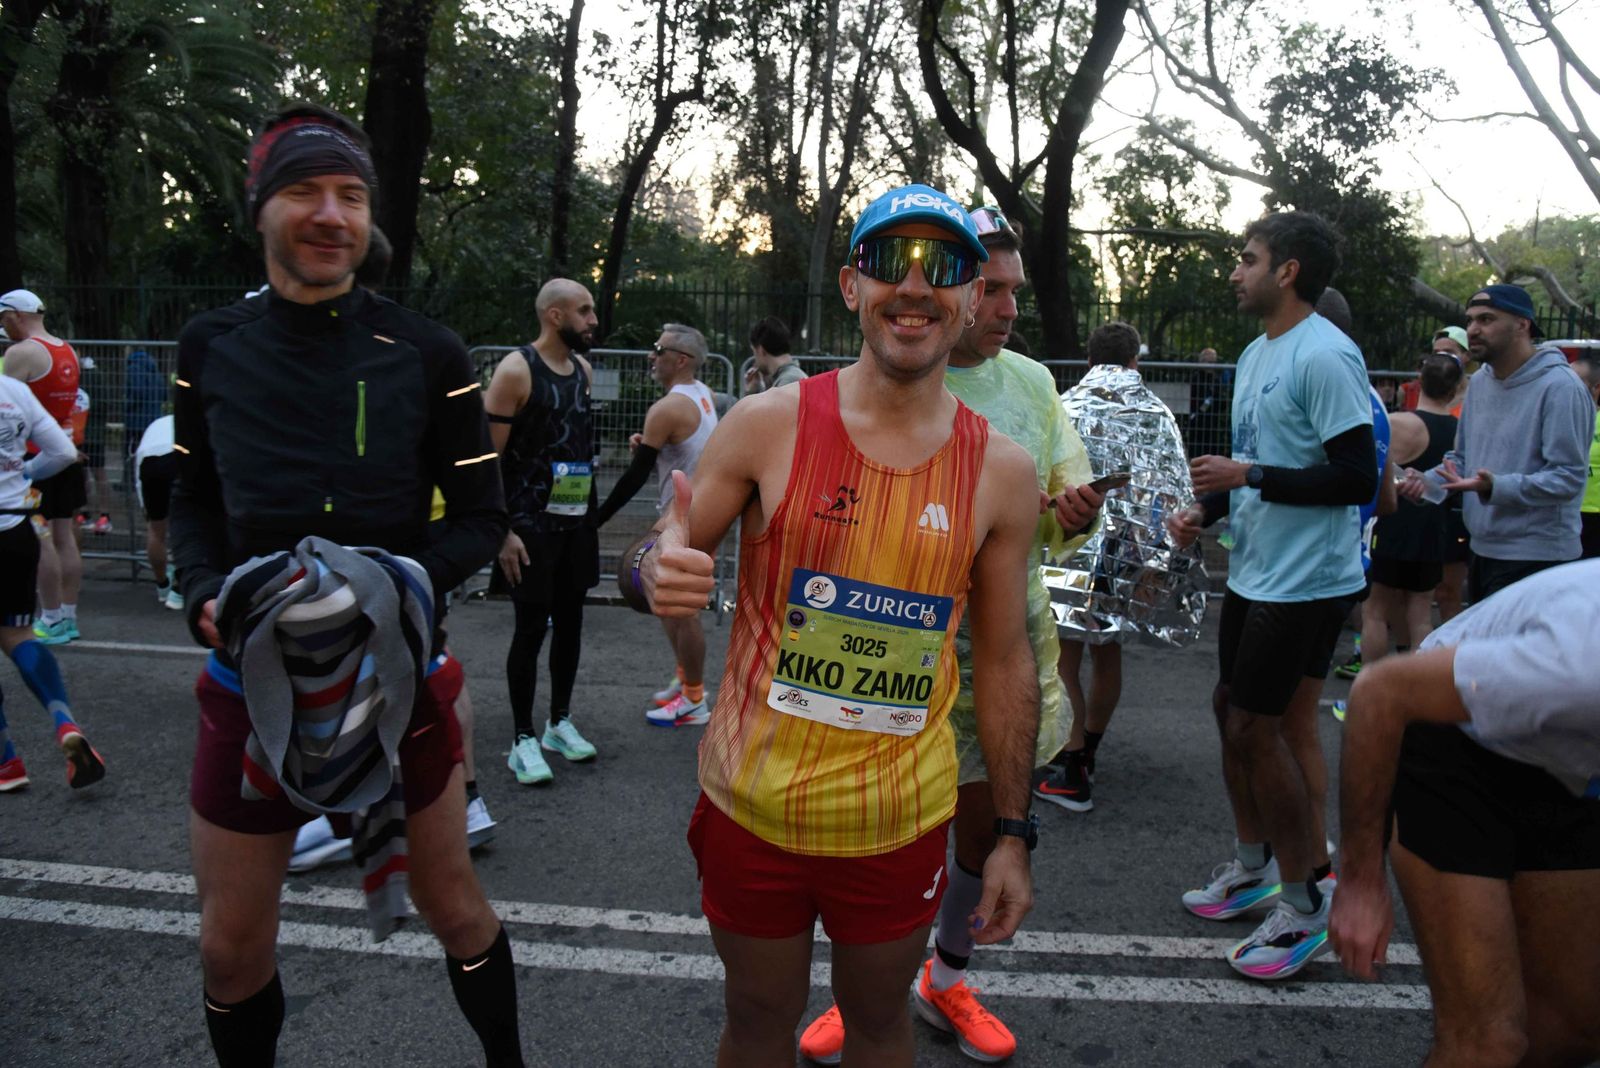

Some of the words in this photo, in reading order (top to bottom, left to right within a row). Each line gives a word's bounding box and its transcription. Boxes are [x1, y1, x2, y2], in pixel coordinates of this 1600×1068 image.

[890, 193, 964, 226] HOKA
[845, 590, 935, 621] ZURICH
[840, 633, 888, 659] 3025
[776, 648, 845, 690] KIKO
[851, 667, 933, 702] ZAMO
